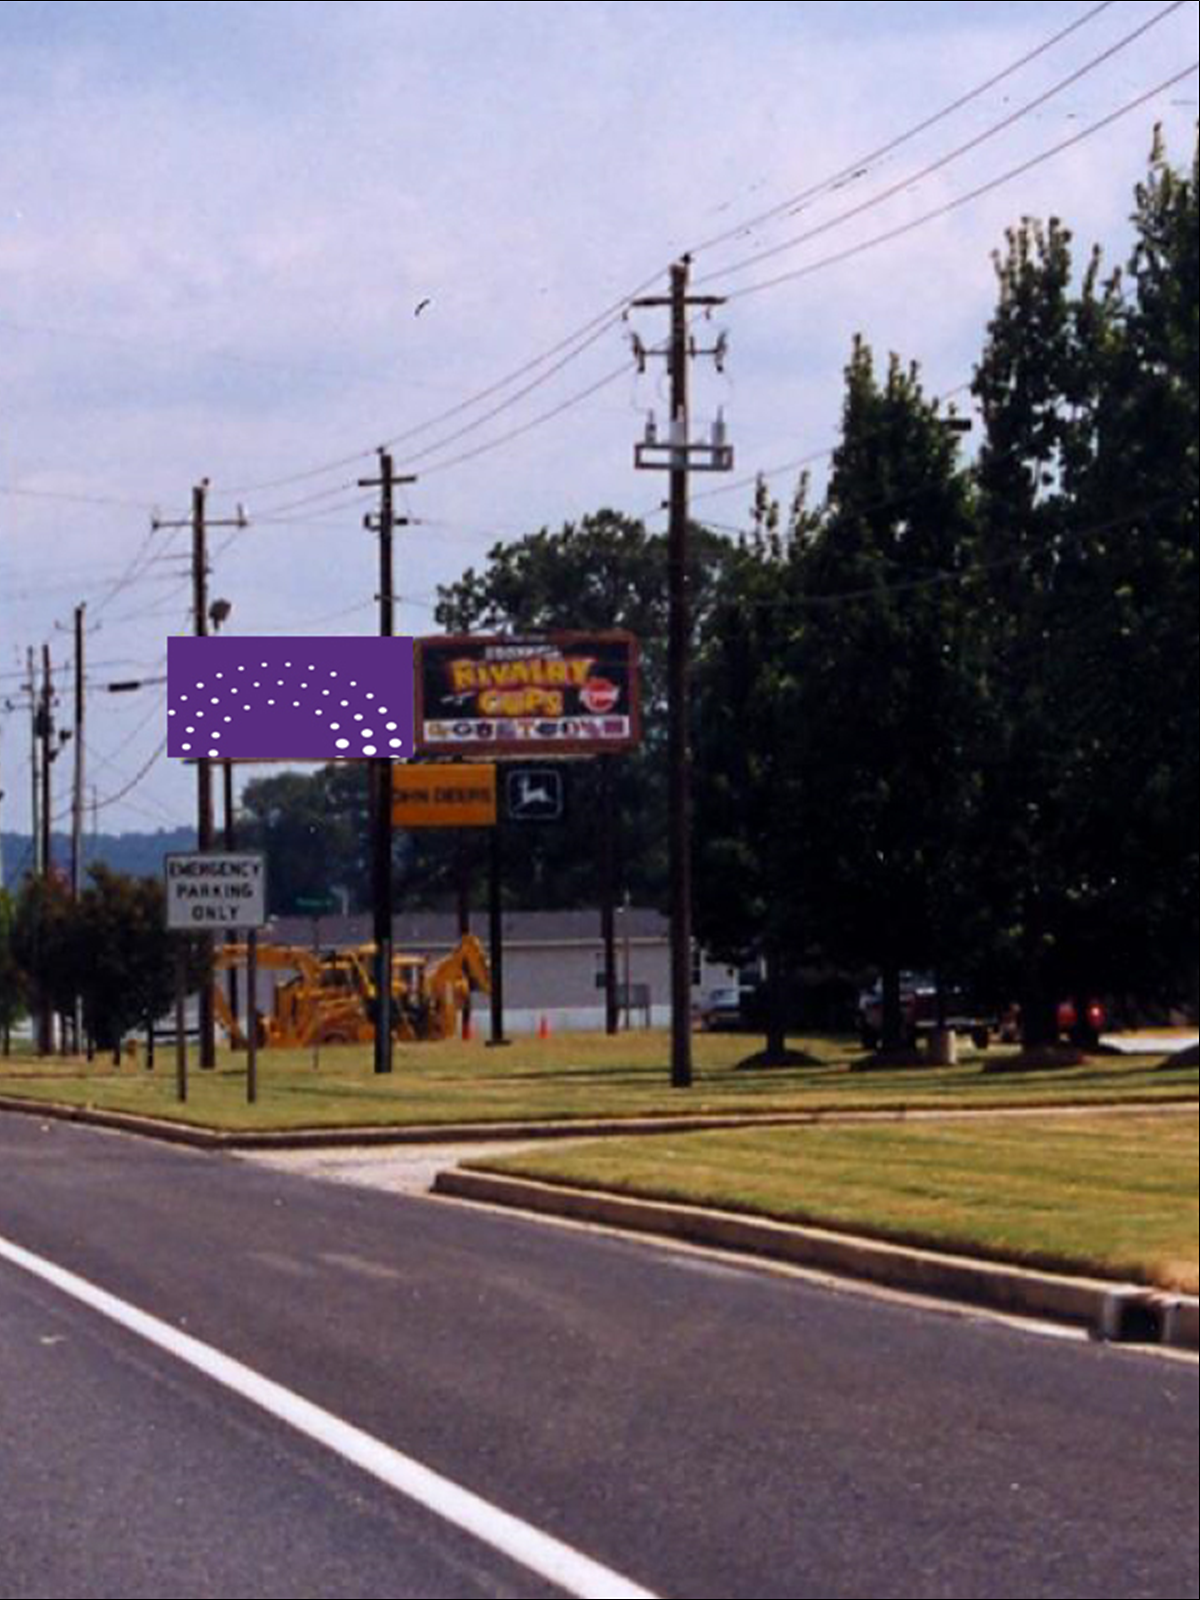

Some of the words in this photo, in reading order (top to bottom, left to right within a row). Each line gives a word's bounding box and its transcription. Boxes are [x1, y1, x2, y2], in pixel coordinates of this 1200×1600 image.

[451, 659, 596, 691] RIVALRY
[169, 862, 259, 878] EMERGENCY
[176, 883, 254, 899] PARKING
[192, 905, 240, 920] ONLY
